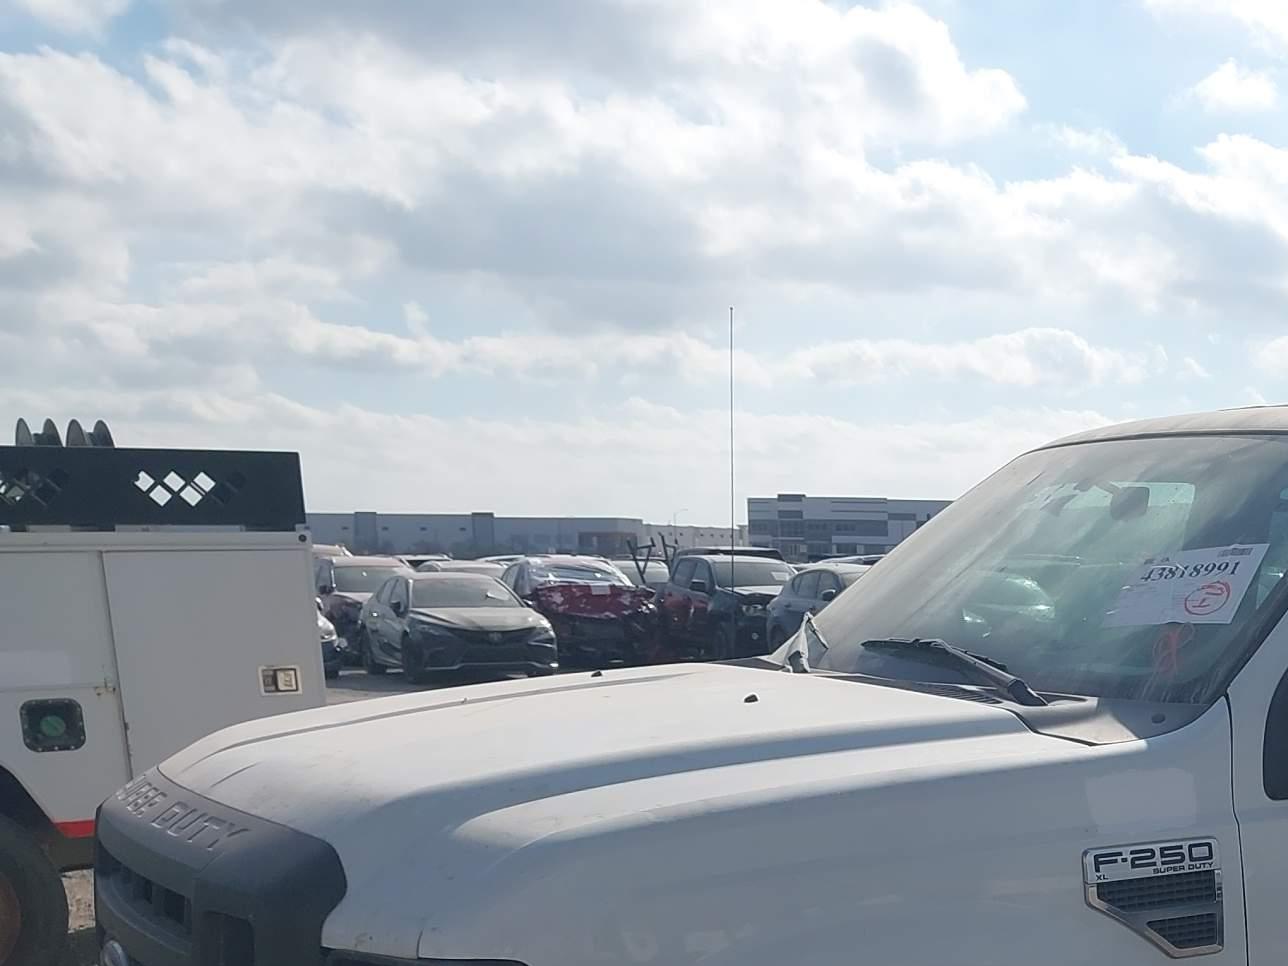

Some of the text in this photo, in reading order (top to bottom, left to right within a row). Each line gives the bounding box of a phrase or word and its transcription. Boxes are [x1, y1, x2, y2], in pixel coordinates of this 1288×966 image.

[1139, 561, 1241, 583] 43818991
[151, 801, 250, 851] DUTY
[1093, 842, 1214, 873] F-250
[1153, 862, 1214, 875] SUPER DUTY
